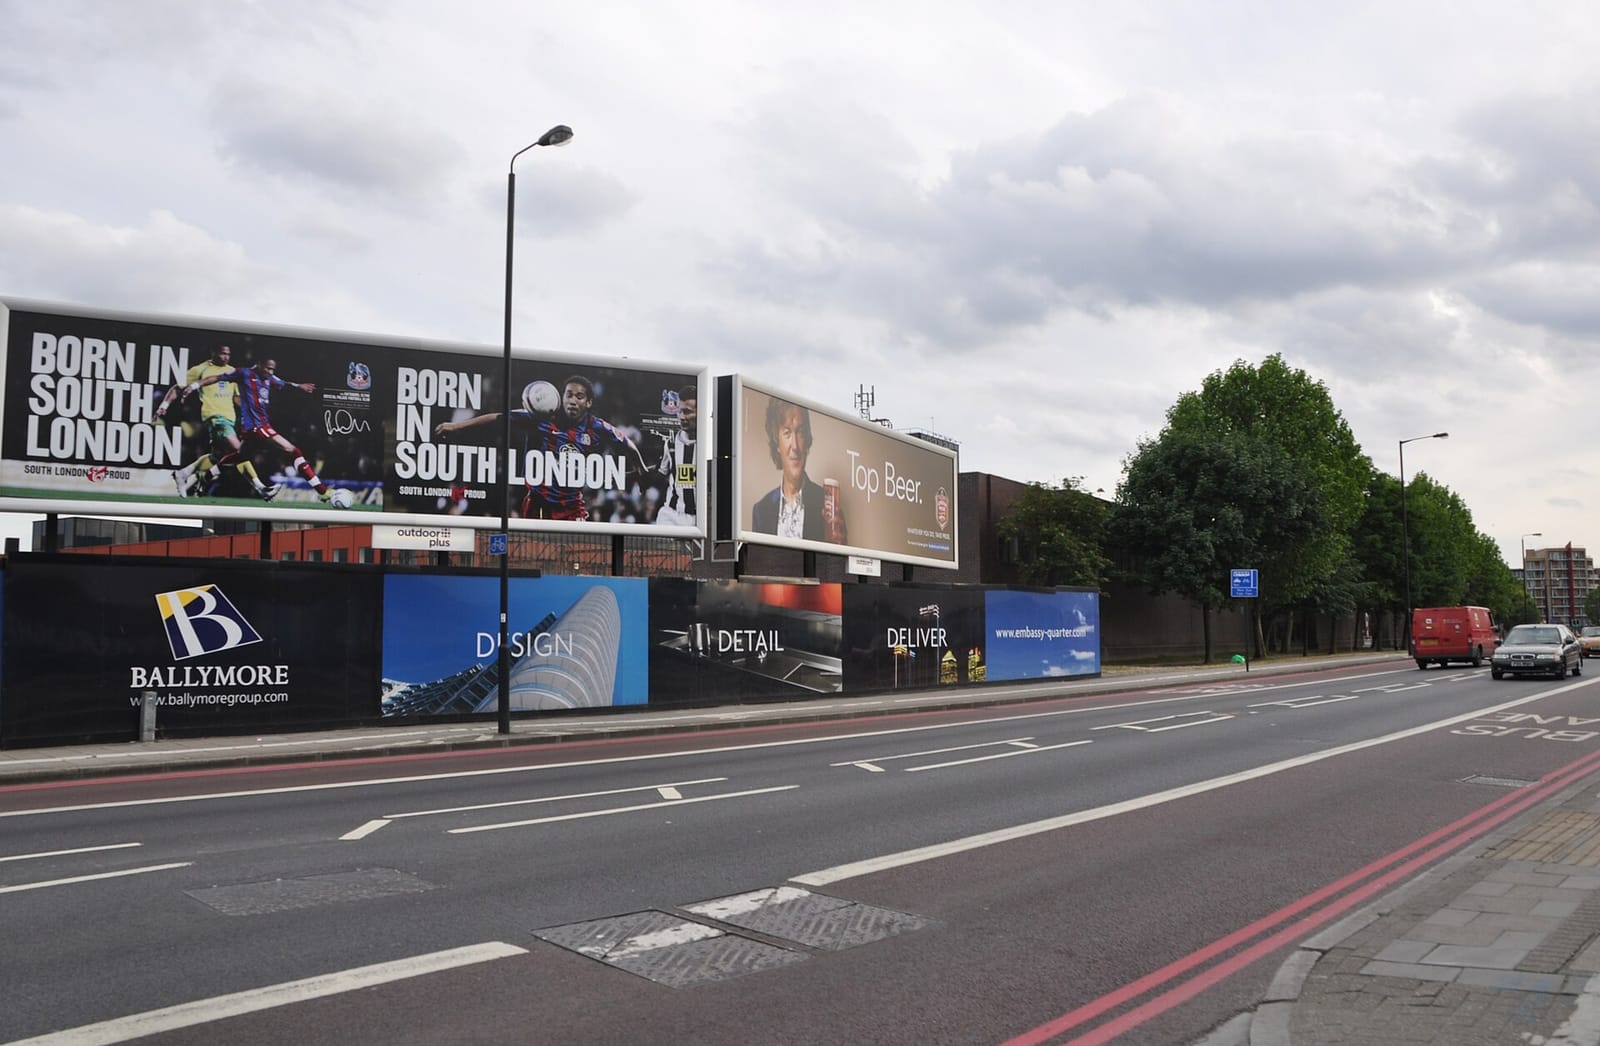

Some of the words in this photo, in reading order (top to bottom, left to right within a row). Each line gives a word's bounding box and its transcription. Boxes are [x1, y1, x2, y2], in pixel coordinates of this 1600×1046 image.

[30, 331, 137, 382] BORN
[149, 344, 189, 386] IN
[28, 373, 152, 424] SOUTH
[397, 366, 483, 410] BORN
[396, 404, 431, 443] IN
[26, 414, 182, 466] LONDON
[24, 464, 52, 475] SOUTH
[54, 466, 89, 478] LONDON
[104, 469, 130, 480] PROUD
[394, 440, 497, 485] SOUTH
[507, 448, 626, 491] LONDON
[846, 449, 880, 503] Top
[884, 461, 923, 505] Beer.
[399, 485, 423, 496] SOUTH
[423, 487, 453, 497] LONDON
[463, 489, 486, 499] PROUD
[397, 527, 440, 538] outdoor
[429, 538, 451, 548] plus
[718, 630, 785, 652] DETAIL
[887, 627, 948, 648] DELIVER
[995, 625, 1087, 640] www.embassy-quarter.com
[476, 632, 573, 658] DSIGN
[130, 665, 289, 688] BALLYMORE
[130, 691, 289, 708] ww.ballymoregroup.com
[1449, 724, 1600, 742] BUS
